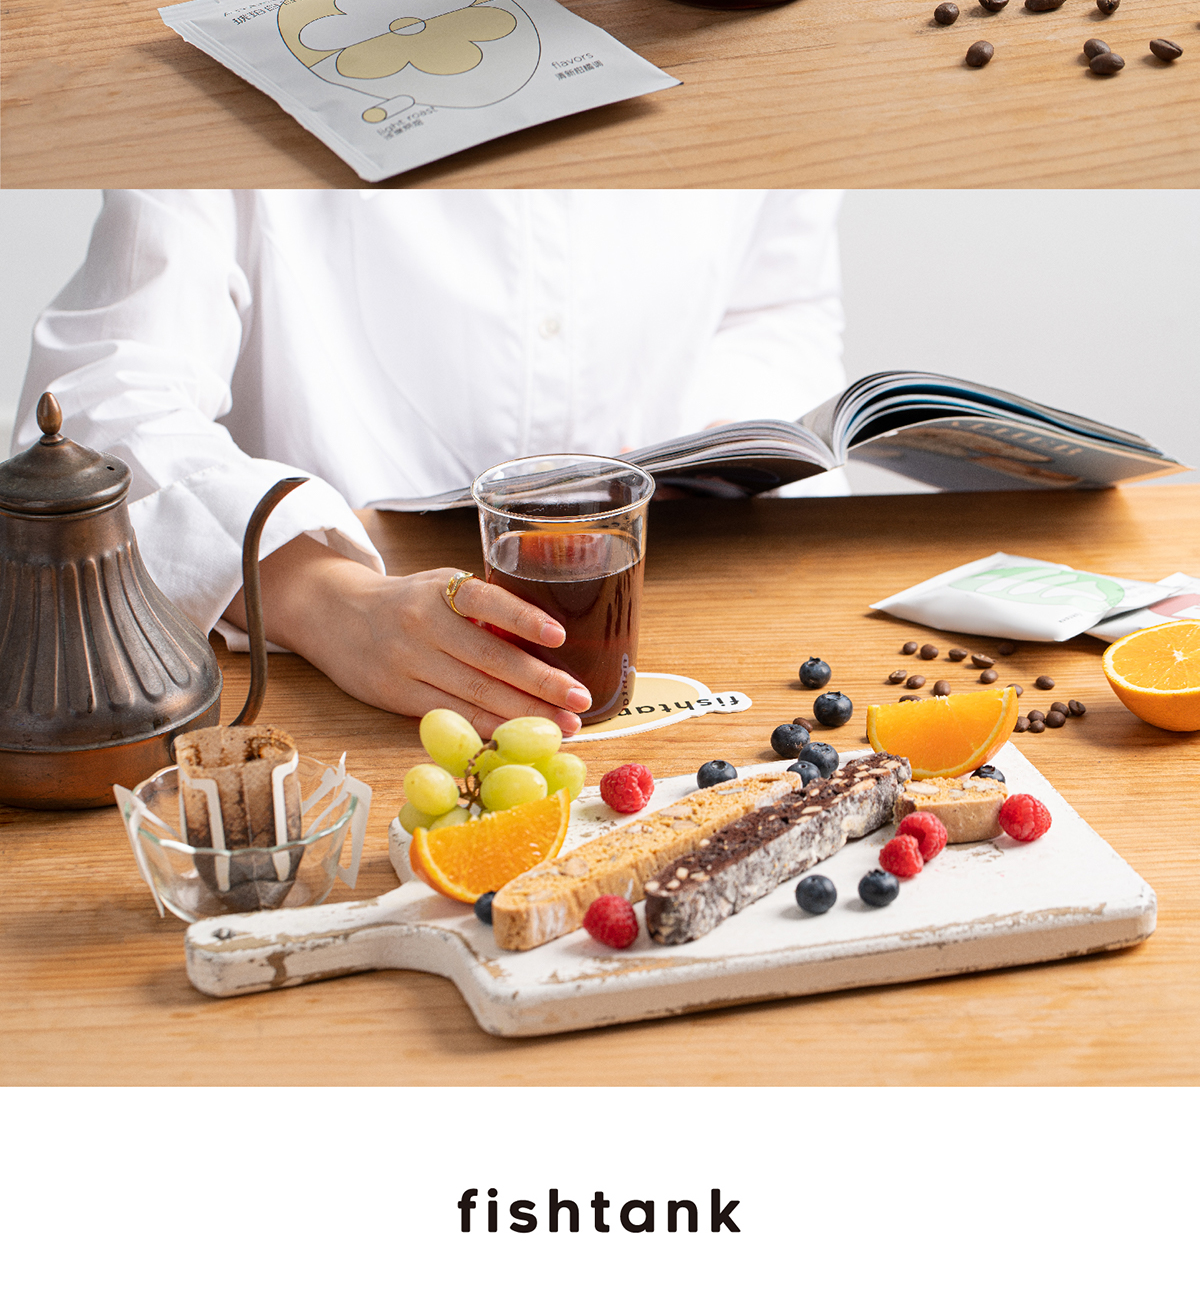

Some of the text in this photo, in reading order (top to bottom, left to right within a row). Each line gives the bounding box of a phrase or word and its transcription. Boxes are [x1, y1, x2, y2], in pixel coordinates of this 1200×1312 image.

[551, 52, 594, 69] flavors
[406, 106, 438, 121] roast
[606, 695, 740, 721] fishtan
